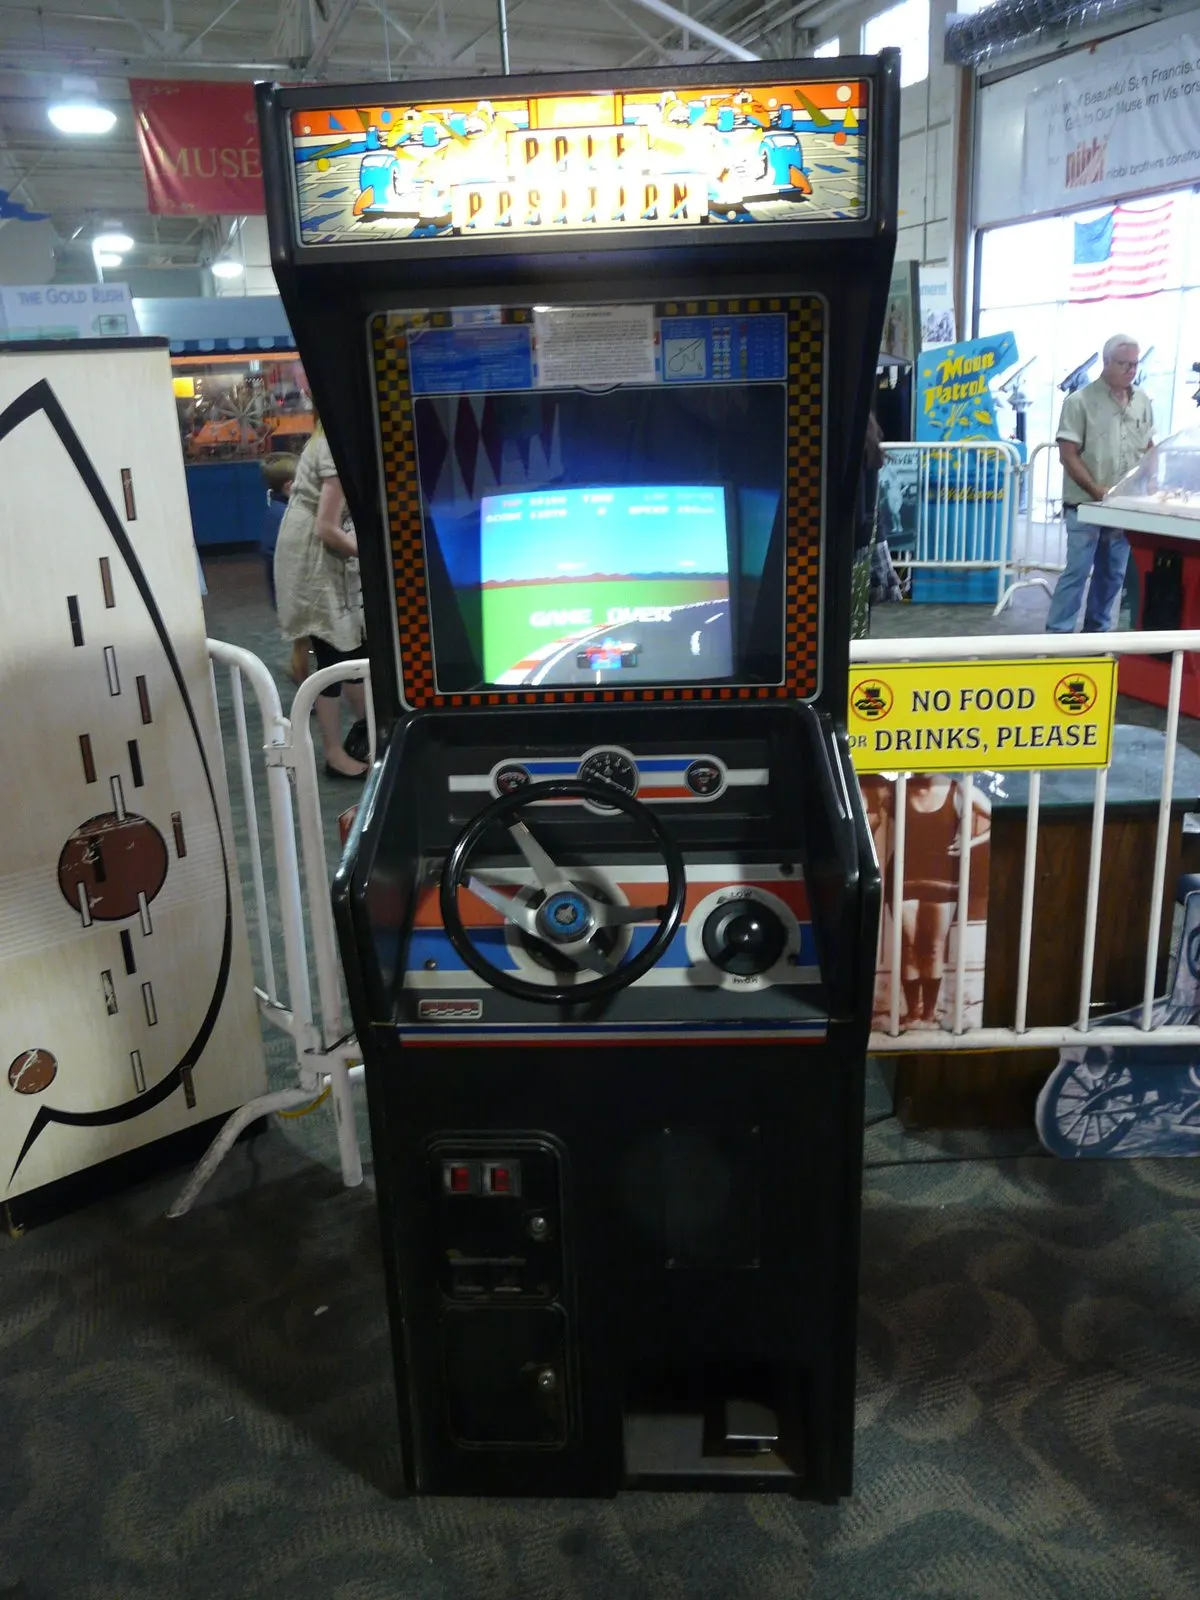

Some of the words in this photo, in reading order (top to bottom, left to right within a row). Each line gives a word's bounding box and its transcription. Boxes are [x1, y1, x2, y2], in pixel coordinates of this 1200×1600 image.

[466, 182, 689, 229] POSITION
[46, 288, 87, 305] GOLD
[936, 352, 994, 383] Moon
[924, 375, 988, 414] Patrol
[912, 689, 951, 712] NO
[959, 688, 1035, 711] FOOD
[848, 735, 867, 748] OR
[875, 727, 988, 753] DRINKS,
[996, 724, 1097, 748] PLEASE
